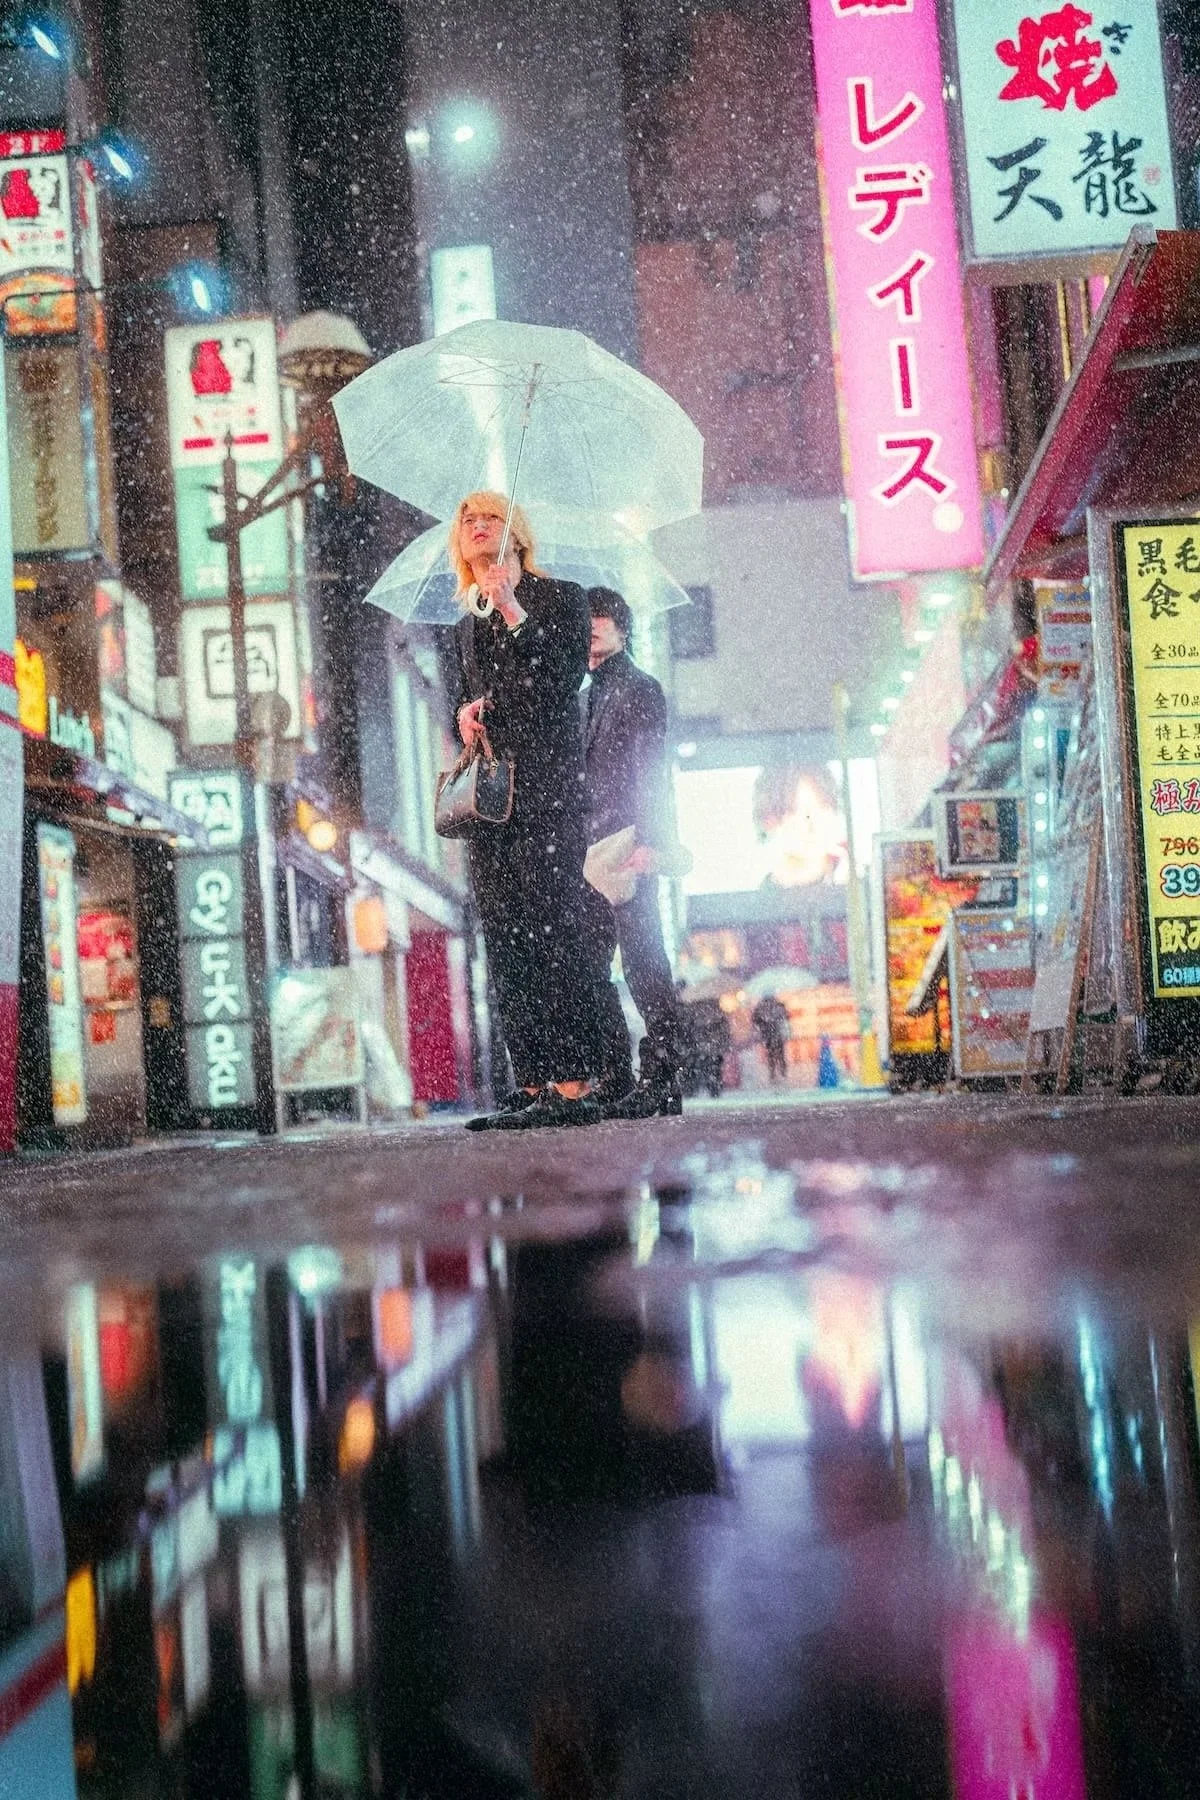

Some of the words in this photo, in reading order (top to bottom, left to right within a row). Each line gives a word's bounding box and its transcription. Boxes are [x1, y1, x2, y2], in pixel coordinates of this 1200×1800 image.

[986, 130, 1158, 222] 天龍
[846, 76, 953, 505] レディース
[1141, 578, 1200, 620] 食
